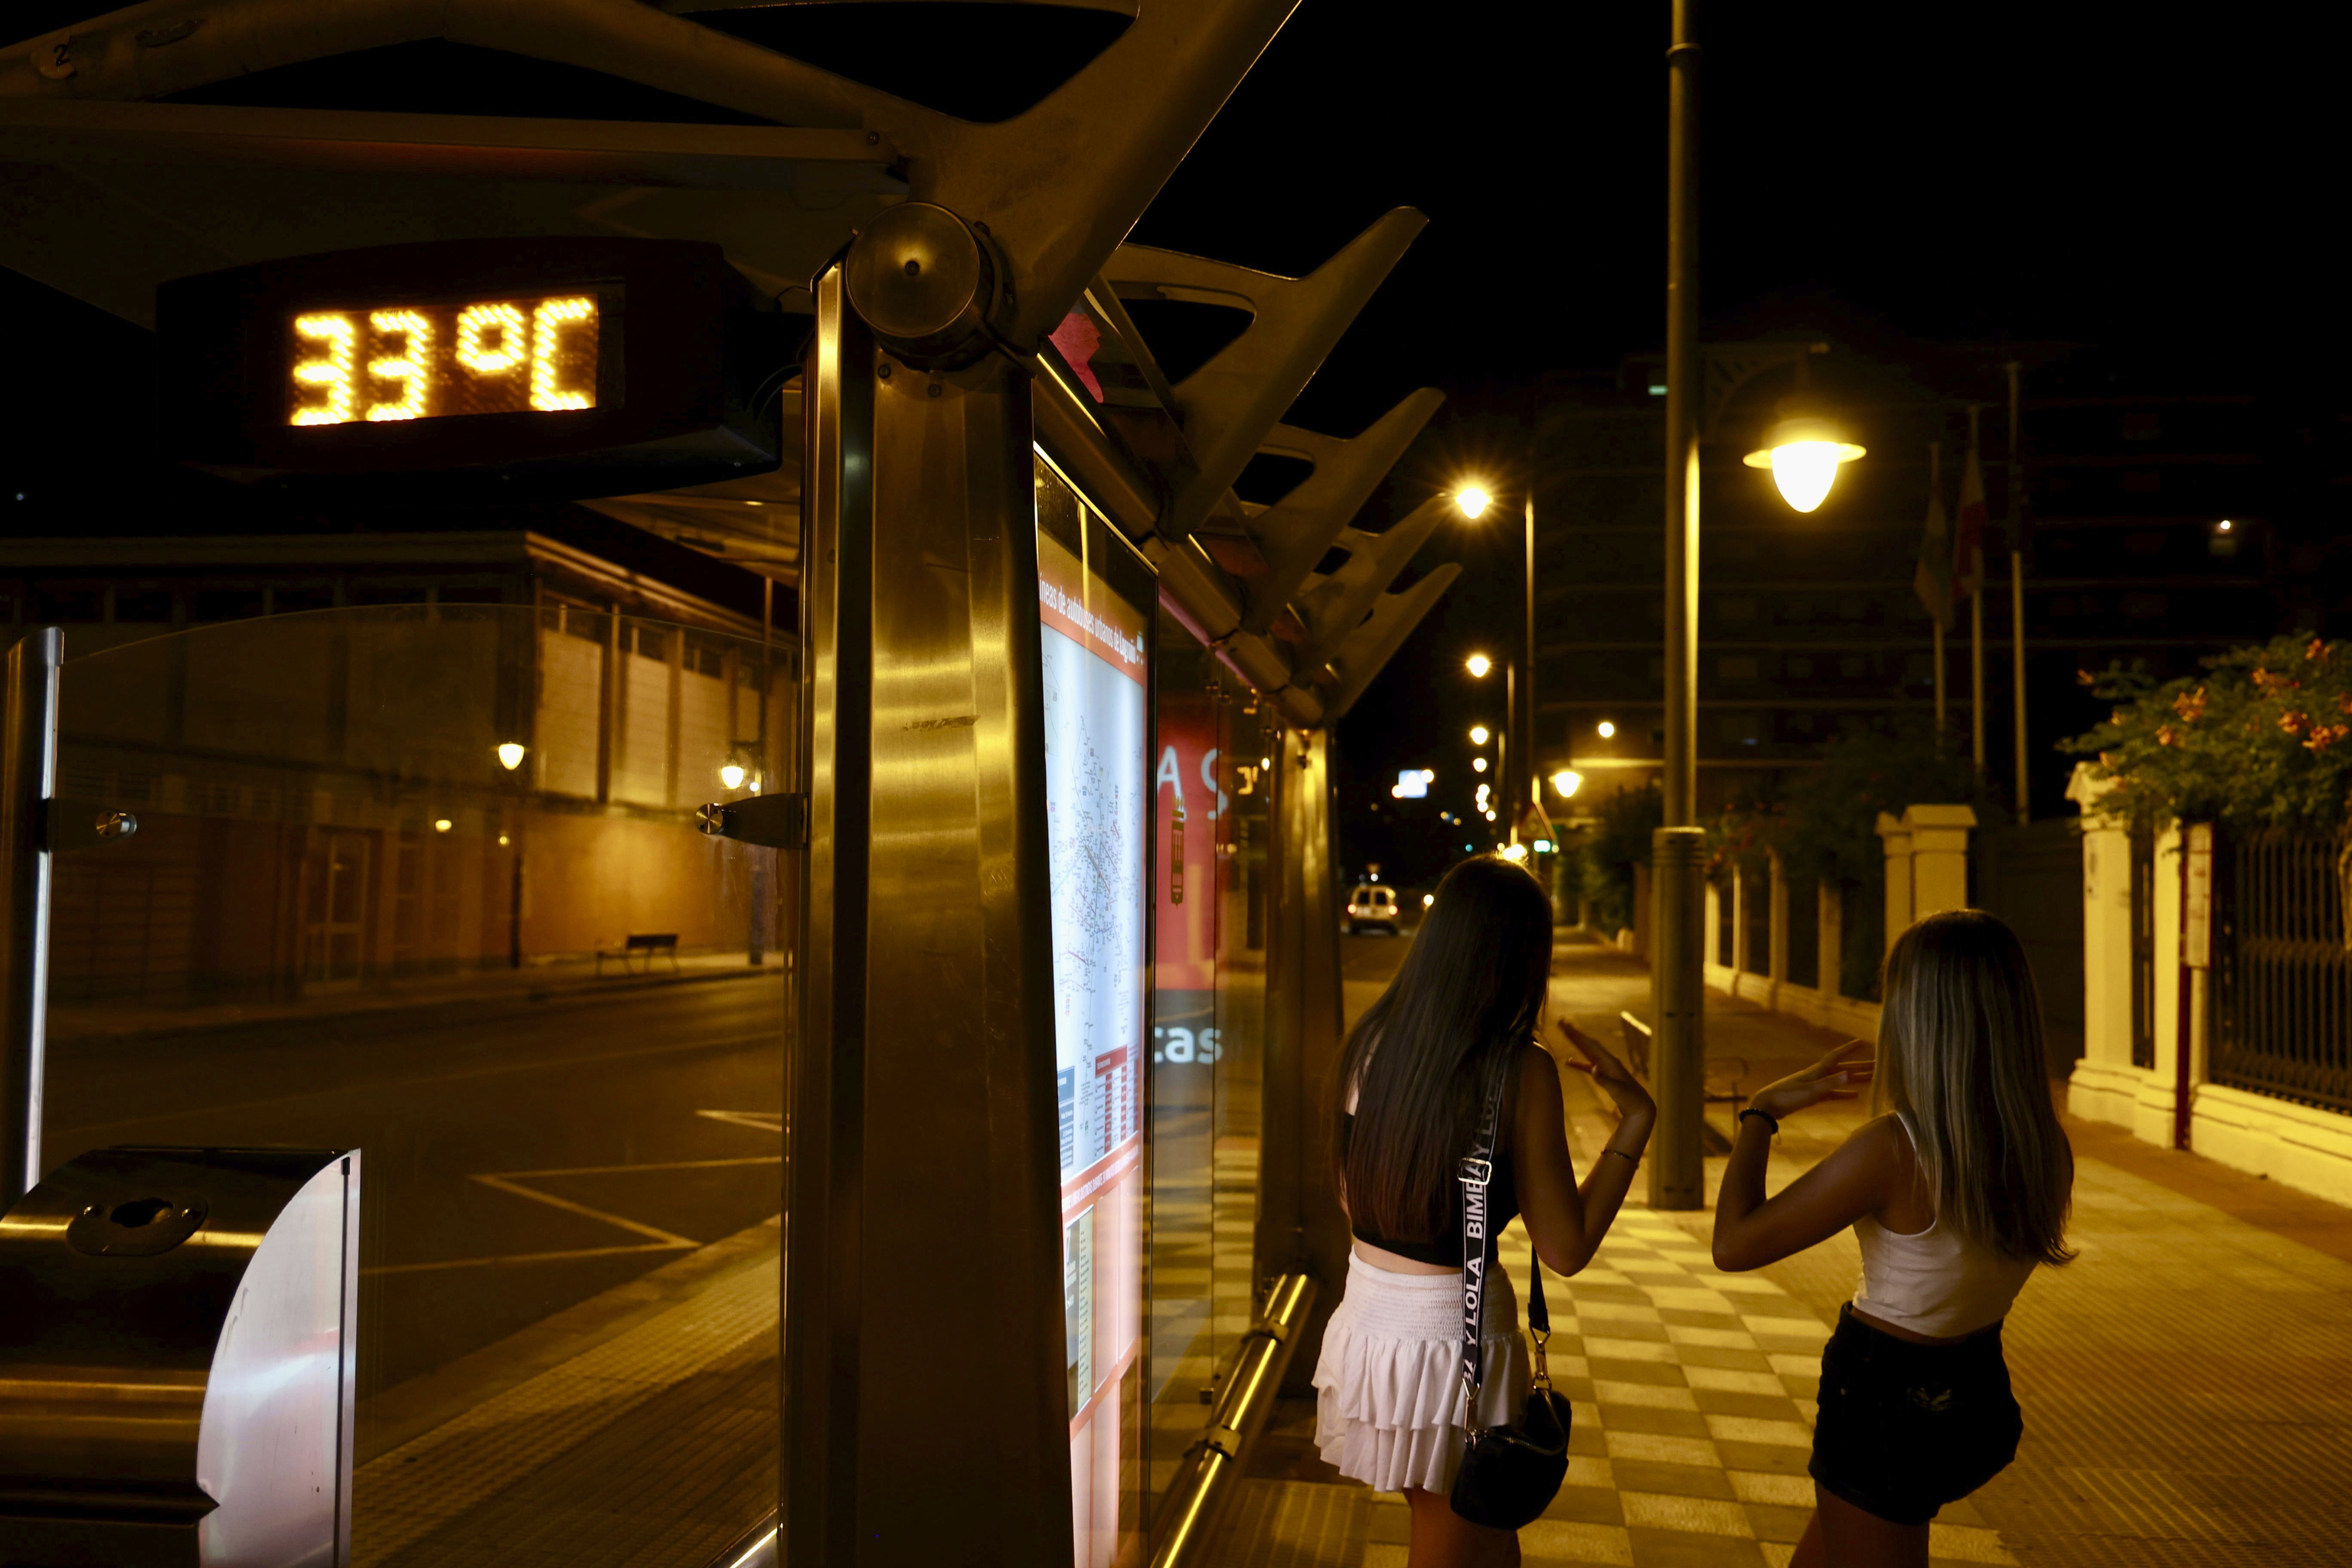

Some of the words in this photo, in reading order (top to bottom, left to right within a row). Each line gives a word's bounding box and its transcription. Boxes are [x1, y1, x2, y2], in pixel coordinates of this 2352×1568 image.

[1058, 586, 1067, 616] de
[1067, 596, 1094, 635] autobuses
[1465, 1256, 1482, 1327] LOLA
